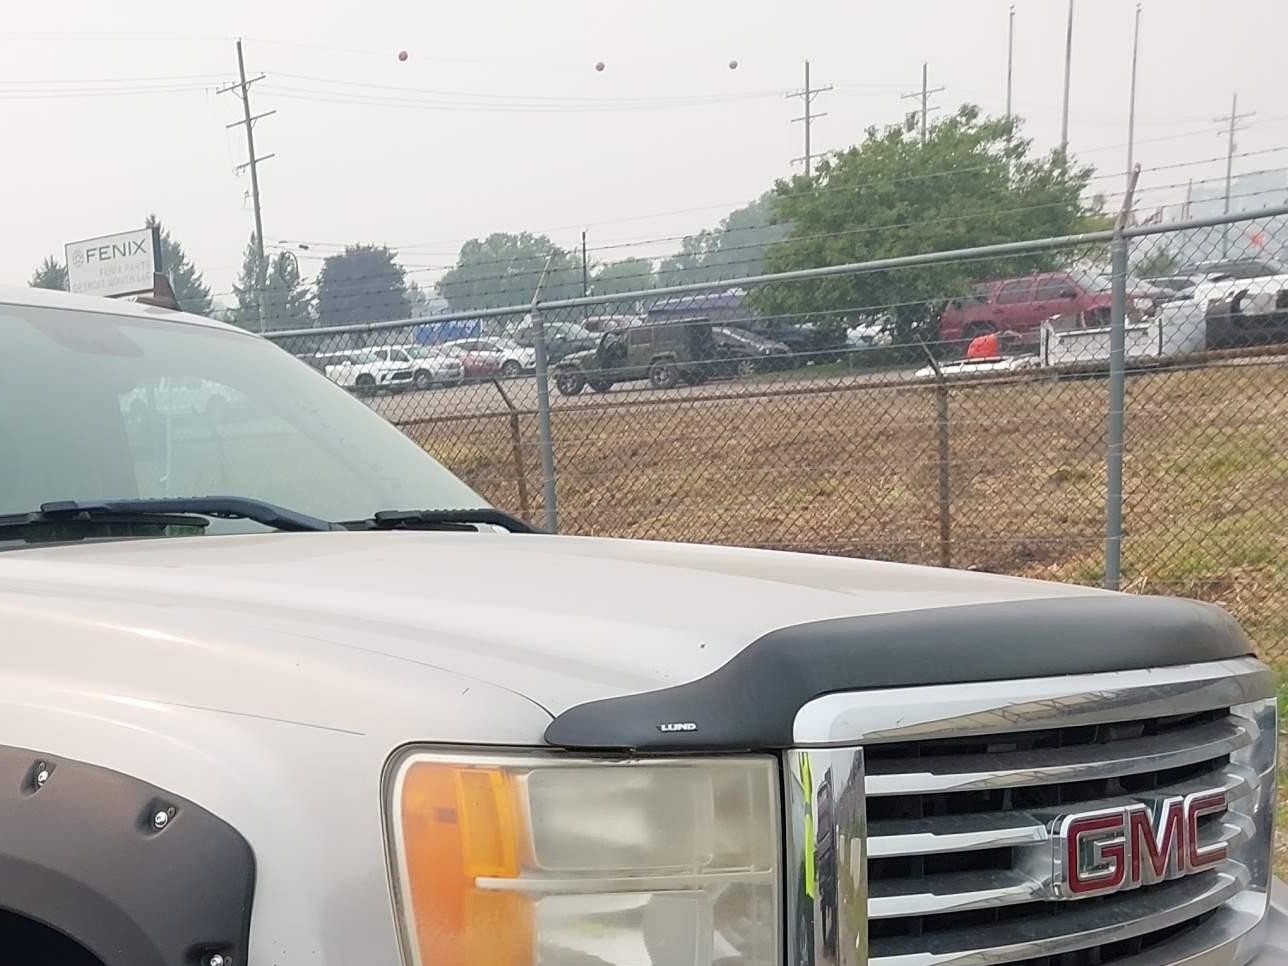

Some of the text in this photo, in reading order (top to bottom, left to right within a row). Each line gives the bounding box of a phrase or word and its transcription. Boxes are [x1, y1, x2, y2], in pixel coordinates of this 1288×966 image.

[86, 238, 147, 264] FENIX
[661, 722, 697, 731] LUND
[1061, 786, 1229, 900] GMC
